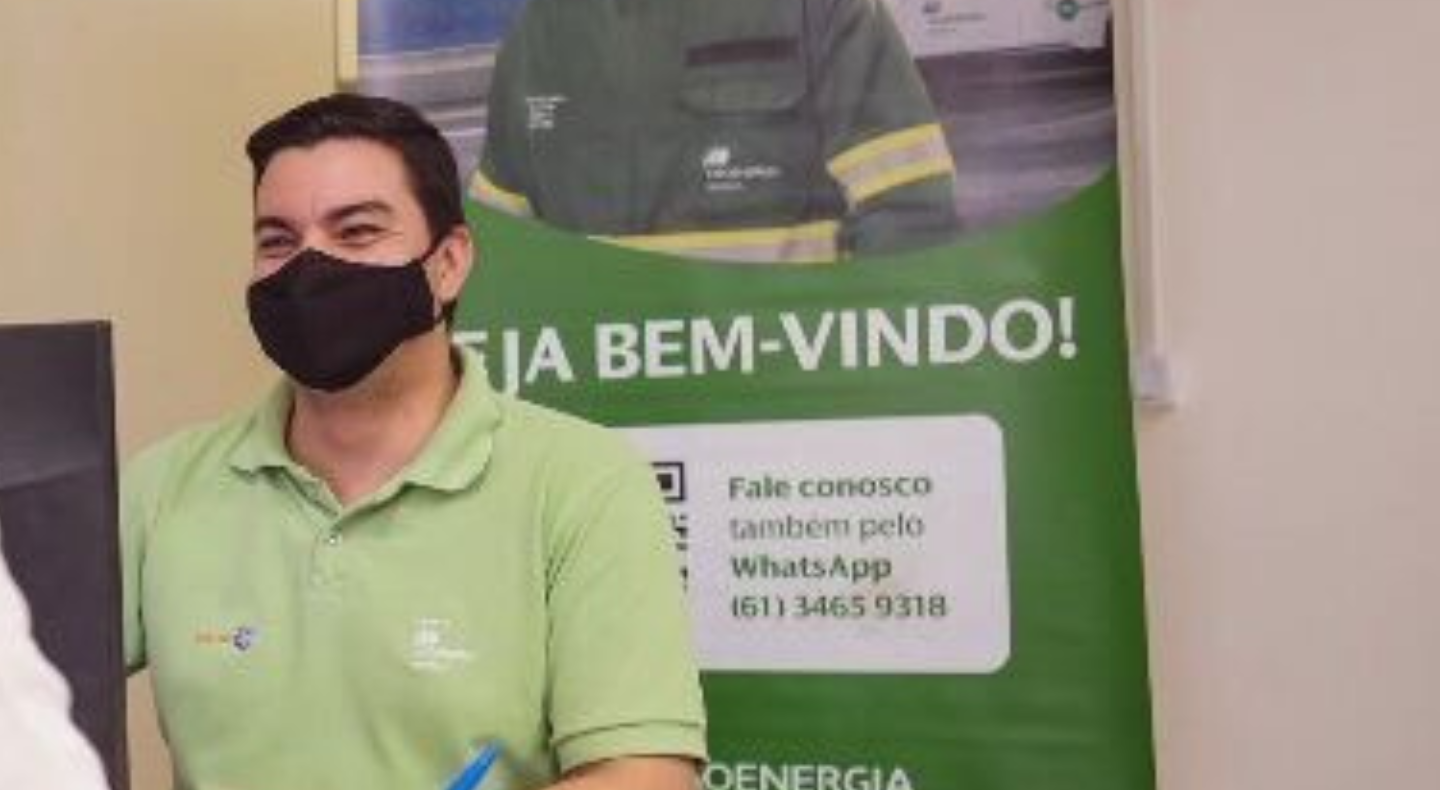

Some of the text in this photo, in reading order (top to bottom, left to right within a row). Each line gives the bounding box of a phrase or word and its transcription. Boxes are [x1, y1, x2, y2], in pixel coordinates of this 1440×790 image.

[452, 297, 1077, 396] JA BEM-VINDO!
[729, 476, 932, 499] Fale conosco
[860, 512, 924, 542] pelo
[732, 554, 892, 583] WhatsApp
[732, 594, 947, 617] (61) 3465 9318
